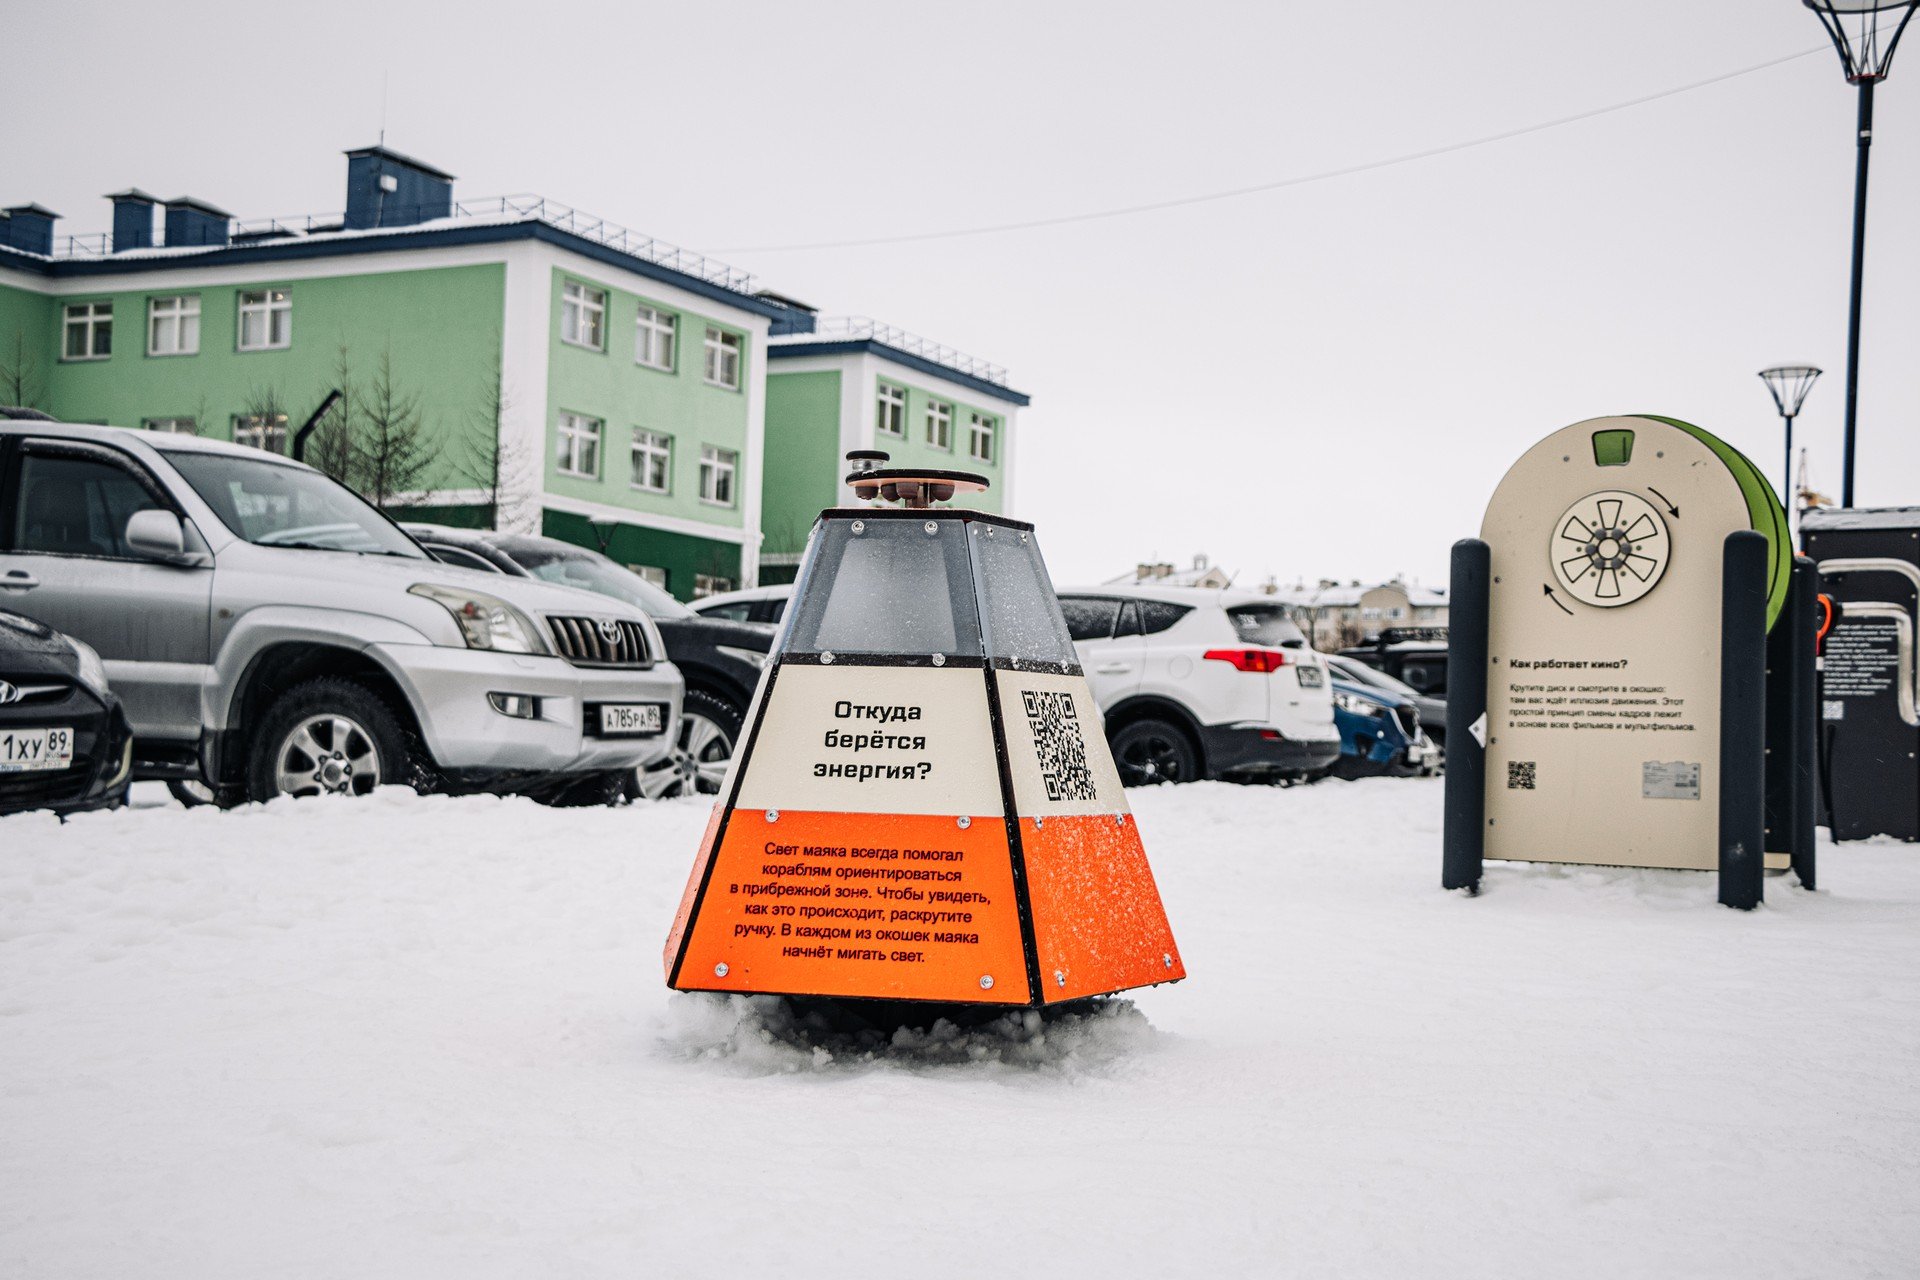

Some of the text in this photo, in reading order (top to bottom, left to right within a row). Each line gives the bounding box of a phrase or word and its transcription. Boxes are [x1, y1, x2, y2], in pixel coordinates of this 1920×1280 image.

[1510, 659, 1628, 670] Как работает кино?
[1510, 684, 1544, 693] Крутите
[1546, 697, 1567, 705] ждёт
[1662, 697, 1684, 706] Этот
[835, 701, 921, 723] Откуда
[1509, 708, 1545, 717] простой
[1547, 710, 1585, 718] принцип
[1619, 711, 1651, 719] кадров
[1573, 722, 1614, 730] фильмов
[1624, 723, 1696, 732] мультфильмов.
[48, 732, 67, 750] 89
[825, 729, 925, 752] берётся
[814, 762, 931, 782] энергия?
[765, 842, 963, 861] Свет маяка всегда помогал
[762, 863, 961, 882] кораблям ориентироваться
[730, 882, 990, 904] в прибрежной зоне. Чтобы увидеть,
[745, 905, 972, 924] как это происходит, раскрутите
[735, 923, 978, 944] ручку. В каждом из окошек маяка
[783, 946, 924, 962] начнёт мигать свет.
